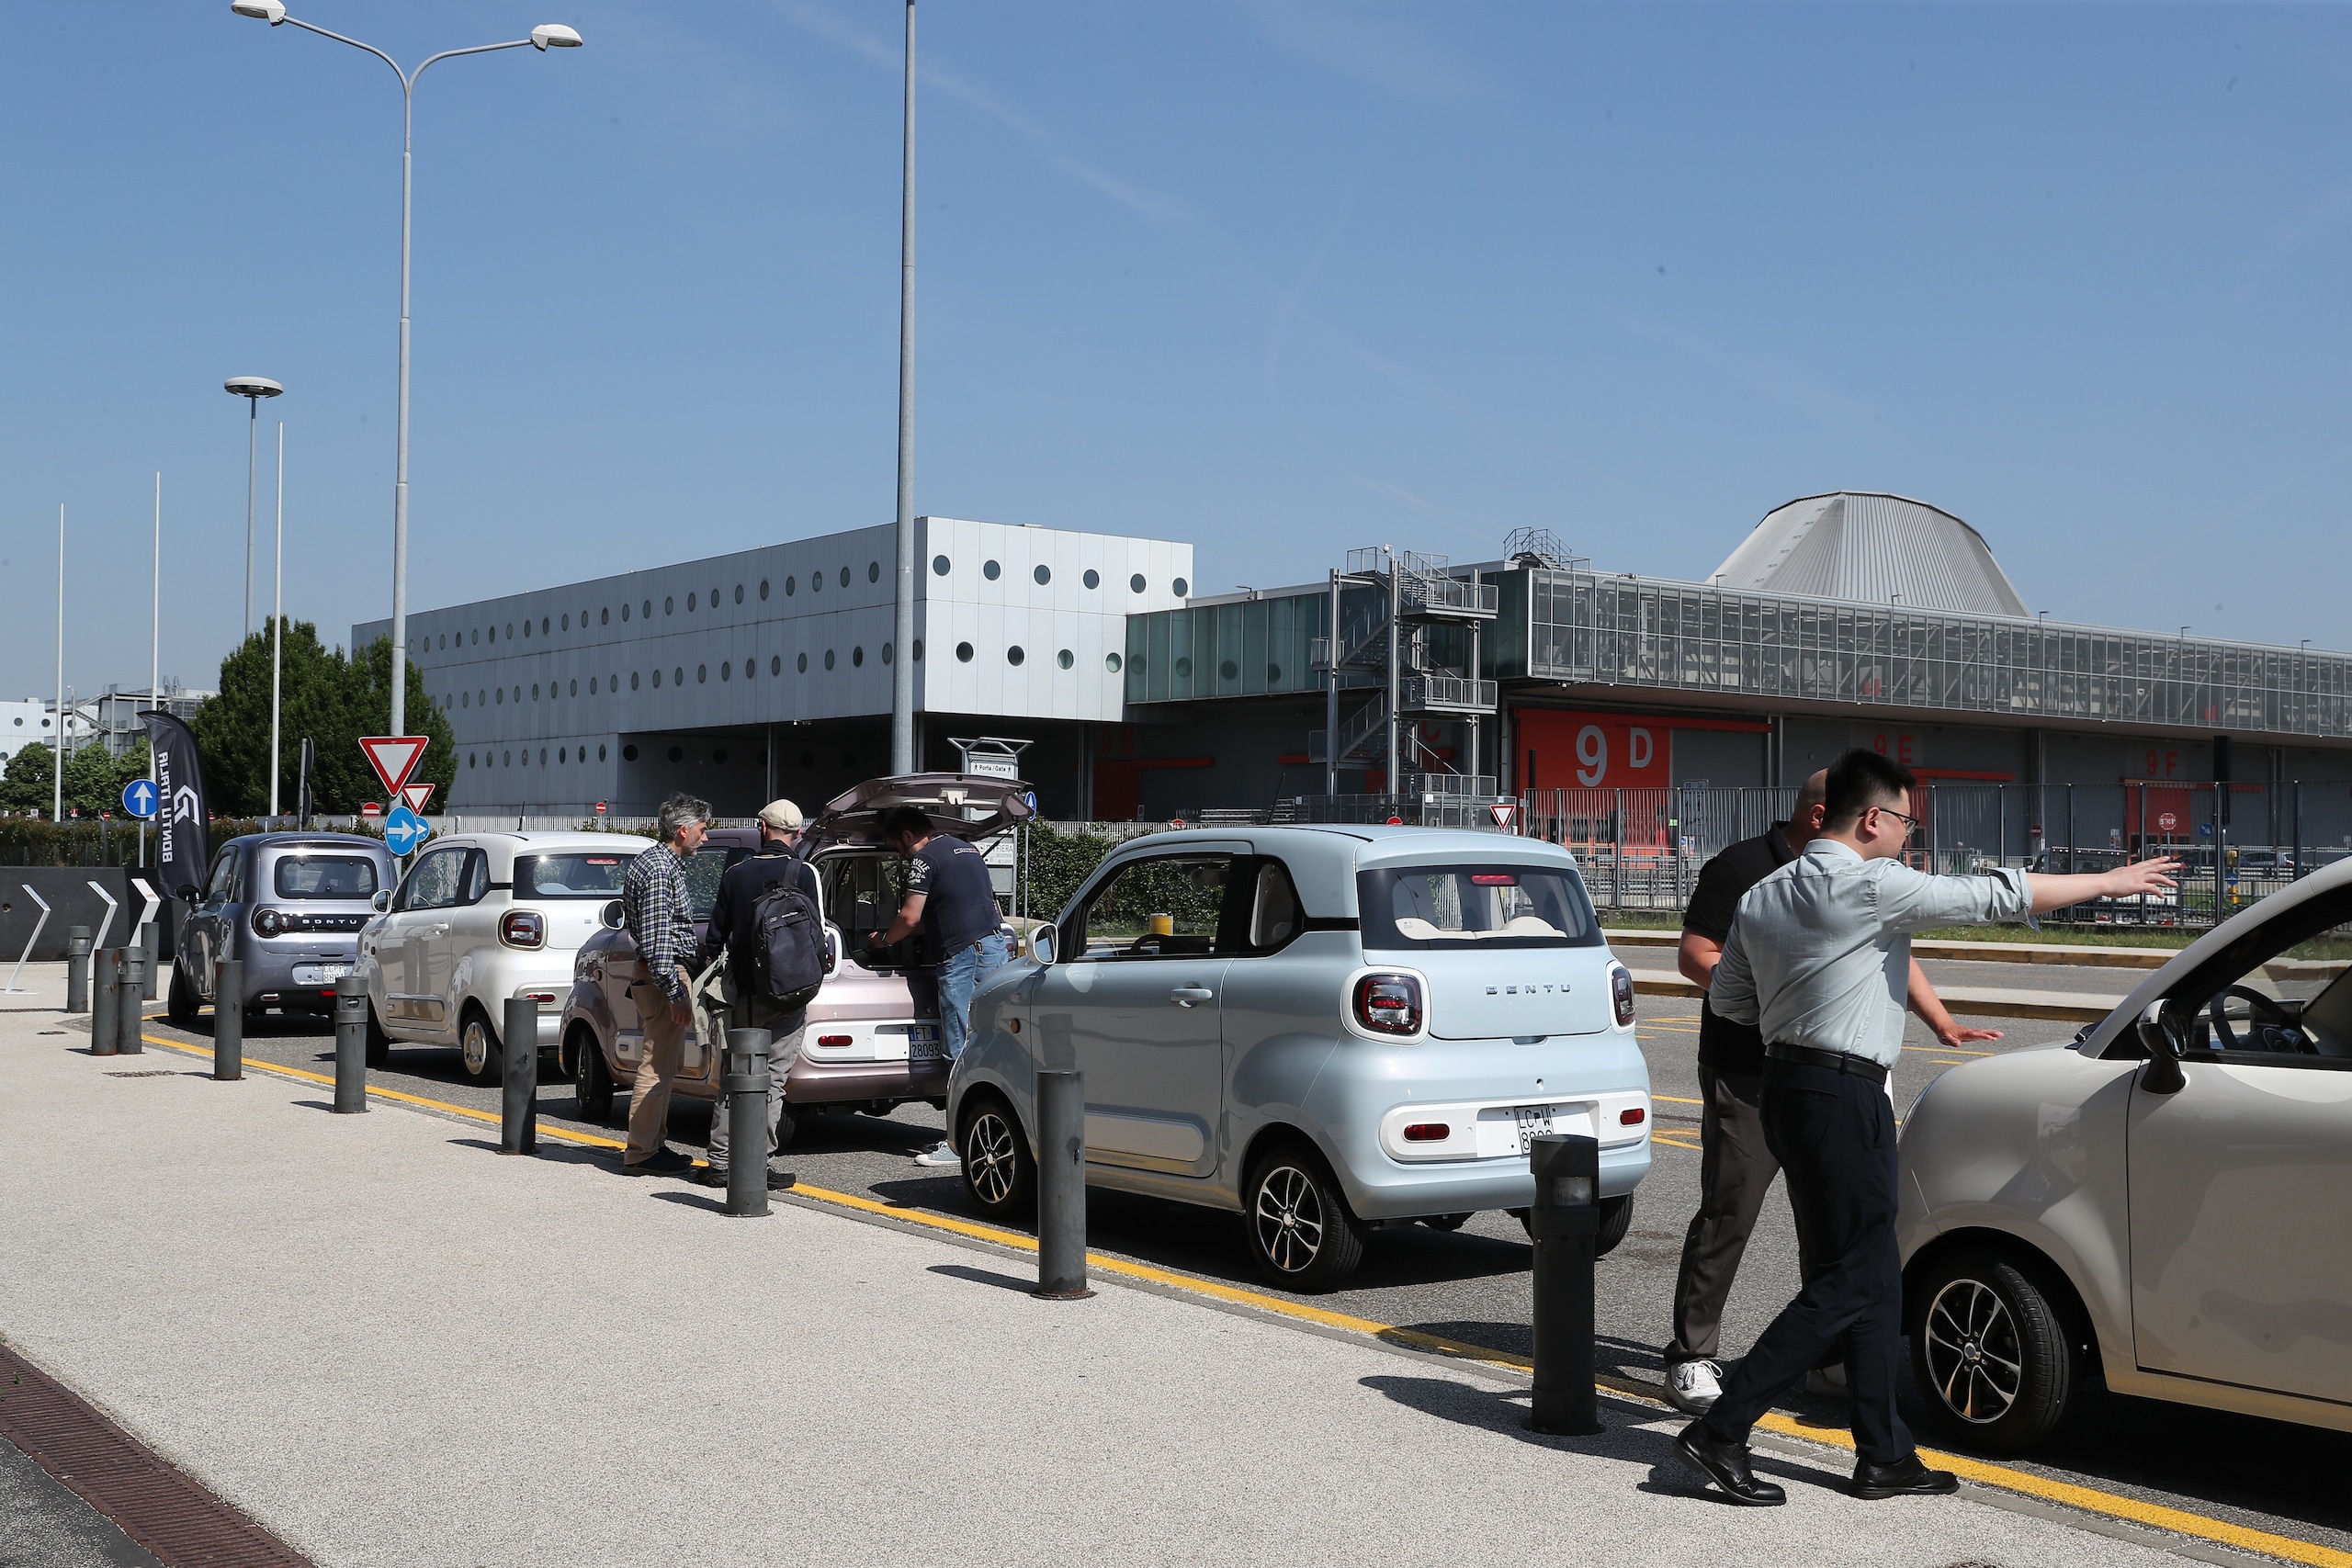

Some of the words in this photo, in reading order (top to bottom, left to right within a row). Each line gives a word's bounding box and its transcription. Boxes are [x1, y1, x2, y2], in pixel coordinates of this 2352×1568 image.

[1576, 725, 1608, 787] 9
[1630, 727, 1654, 768] D
[1898, 736, 1913, 763] E
[2146, 750, 2158, 776] 9
[2165, 751, 2178, 777] F
[914, 1027, 926, 1040] FT
[911, 1043, 940, 1058] 28093
